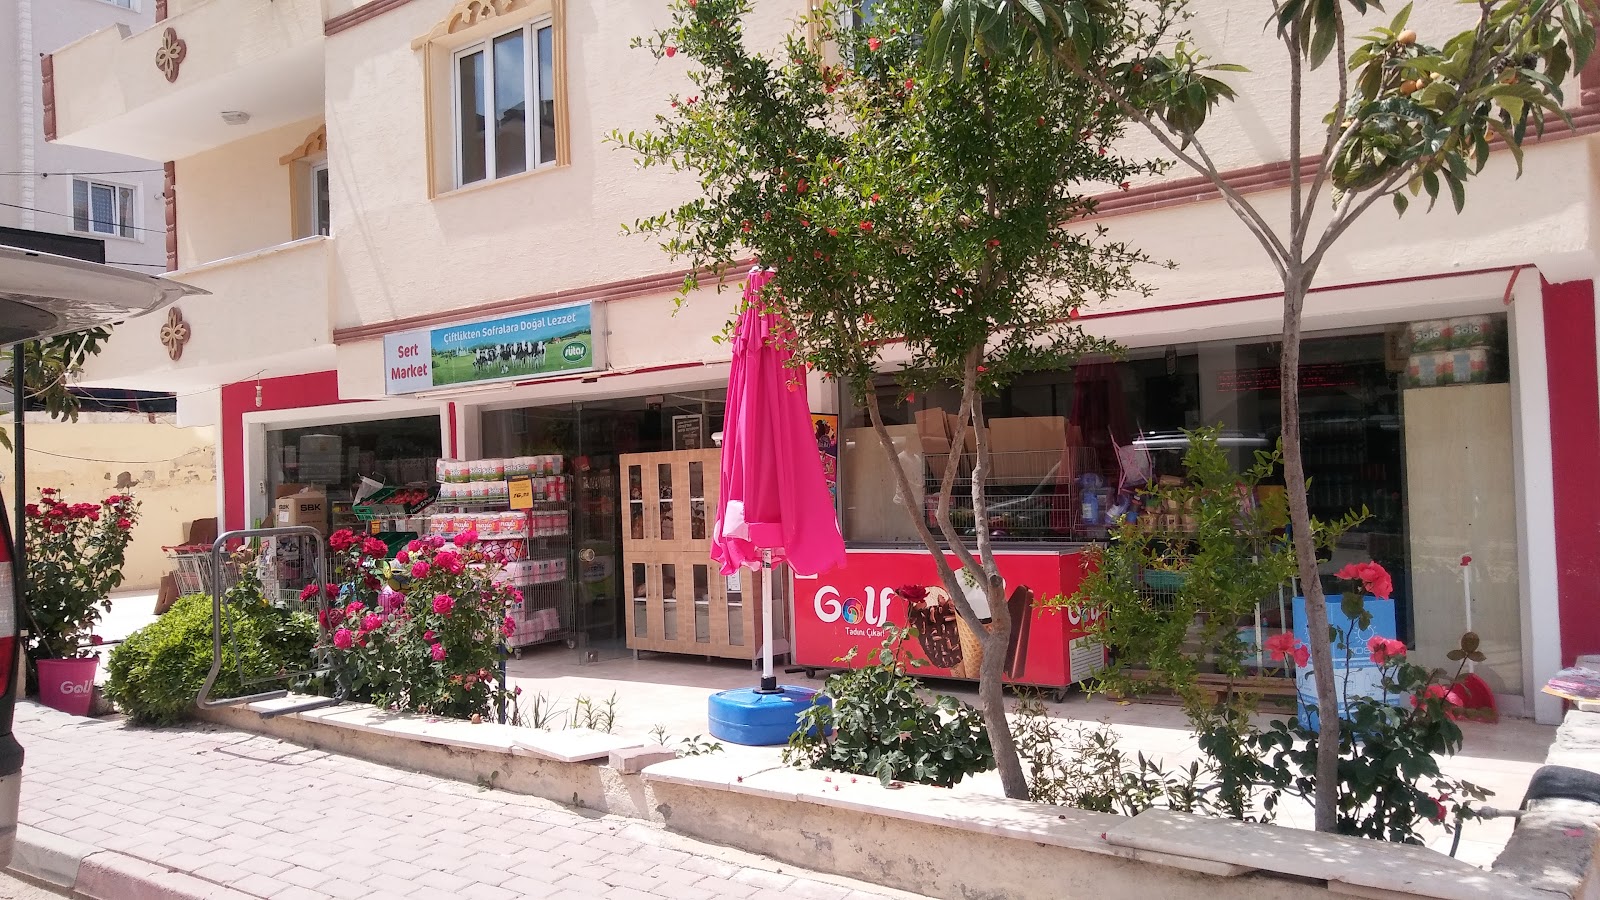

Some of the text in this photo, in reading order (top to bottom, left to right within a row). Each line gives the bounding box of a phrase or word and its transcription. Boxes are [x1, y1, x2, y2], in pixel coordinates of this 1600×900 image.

[444, 312, 576, 344] Çiftlikten Sofralara Doğal Lezzet
[1415, 330, 1440, 340] Solo
[1454, 325, 1480, 335] Solo
[398, 343, 419, 358] Sert
[391, 363, 428, 380] Market
[300, 503, 321, 512] SBK
[814, 585, 897, 628] Golf
[866, 627, 885, 639] Çıkar!
[60, 679, 93, 695] Golf
